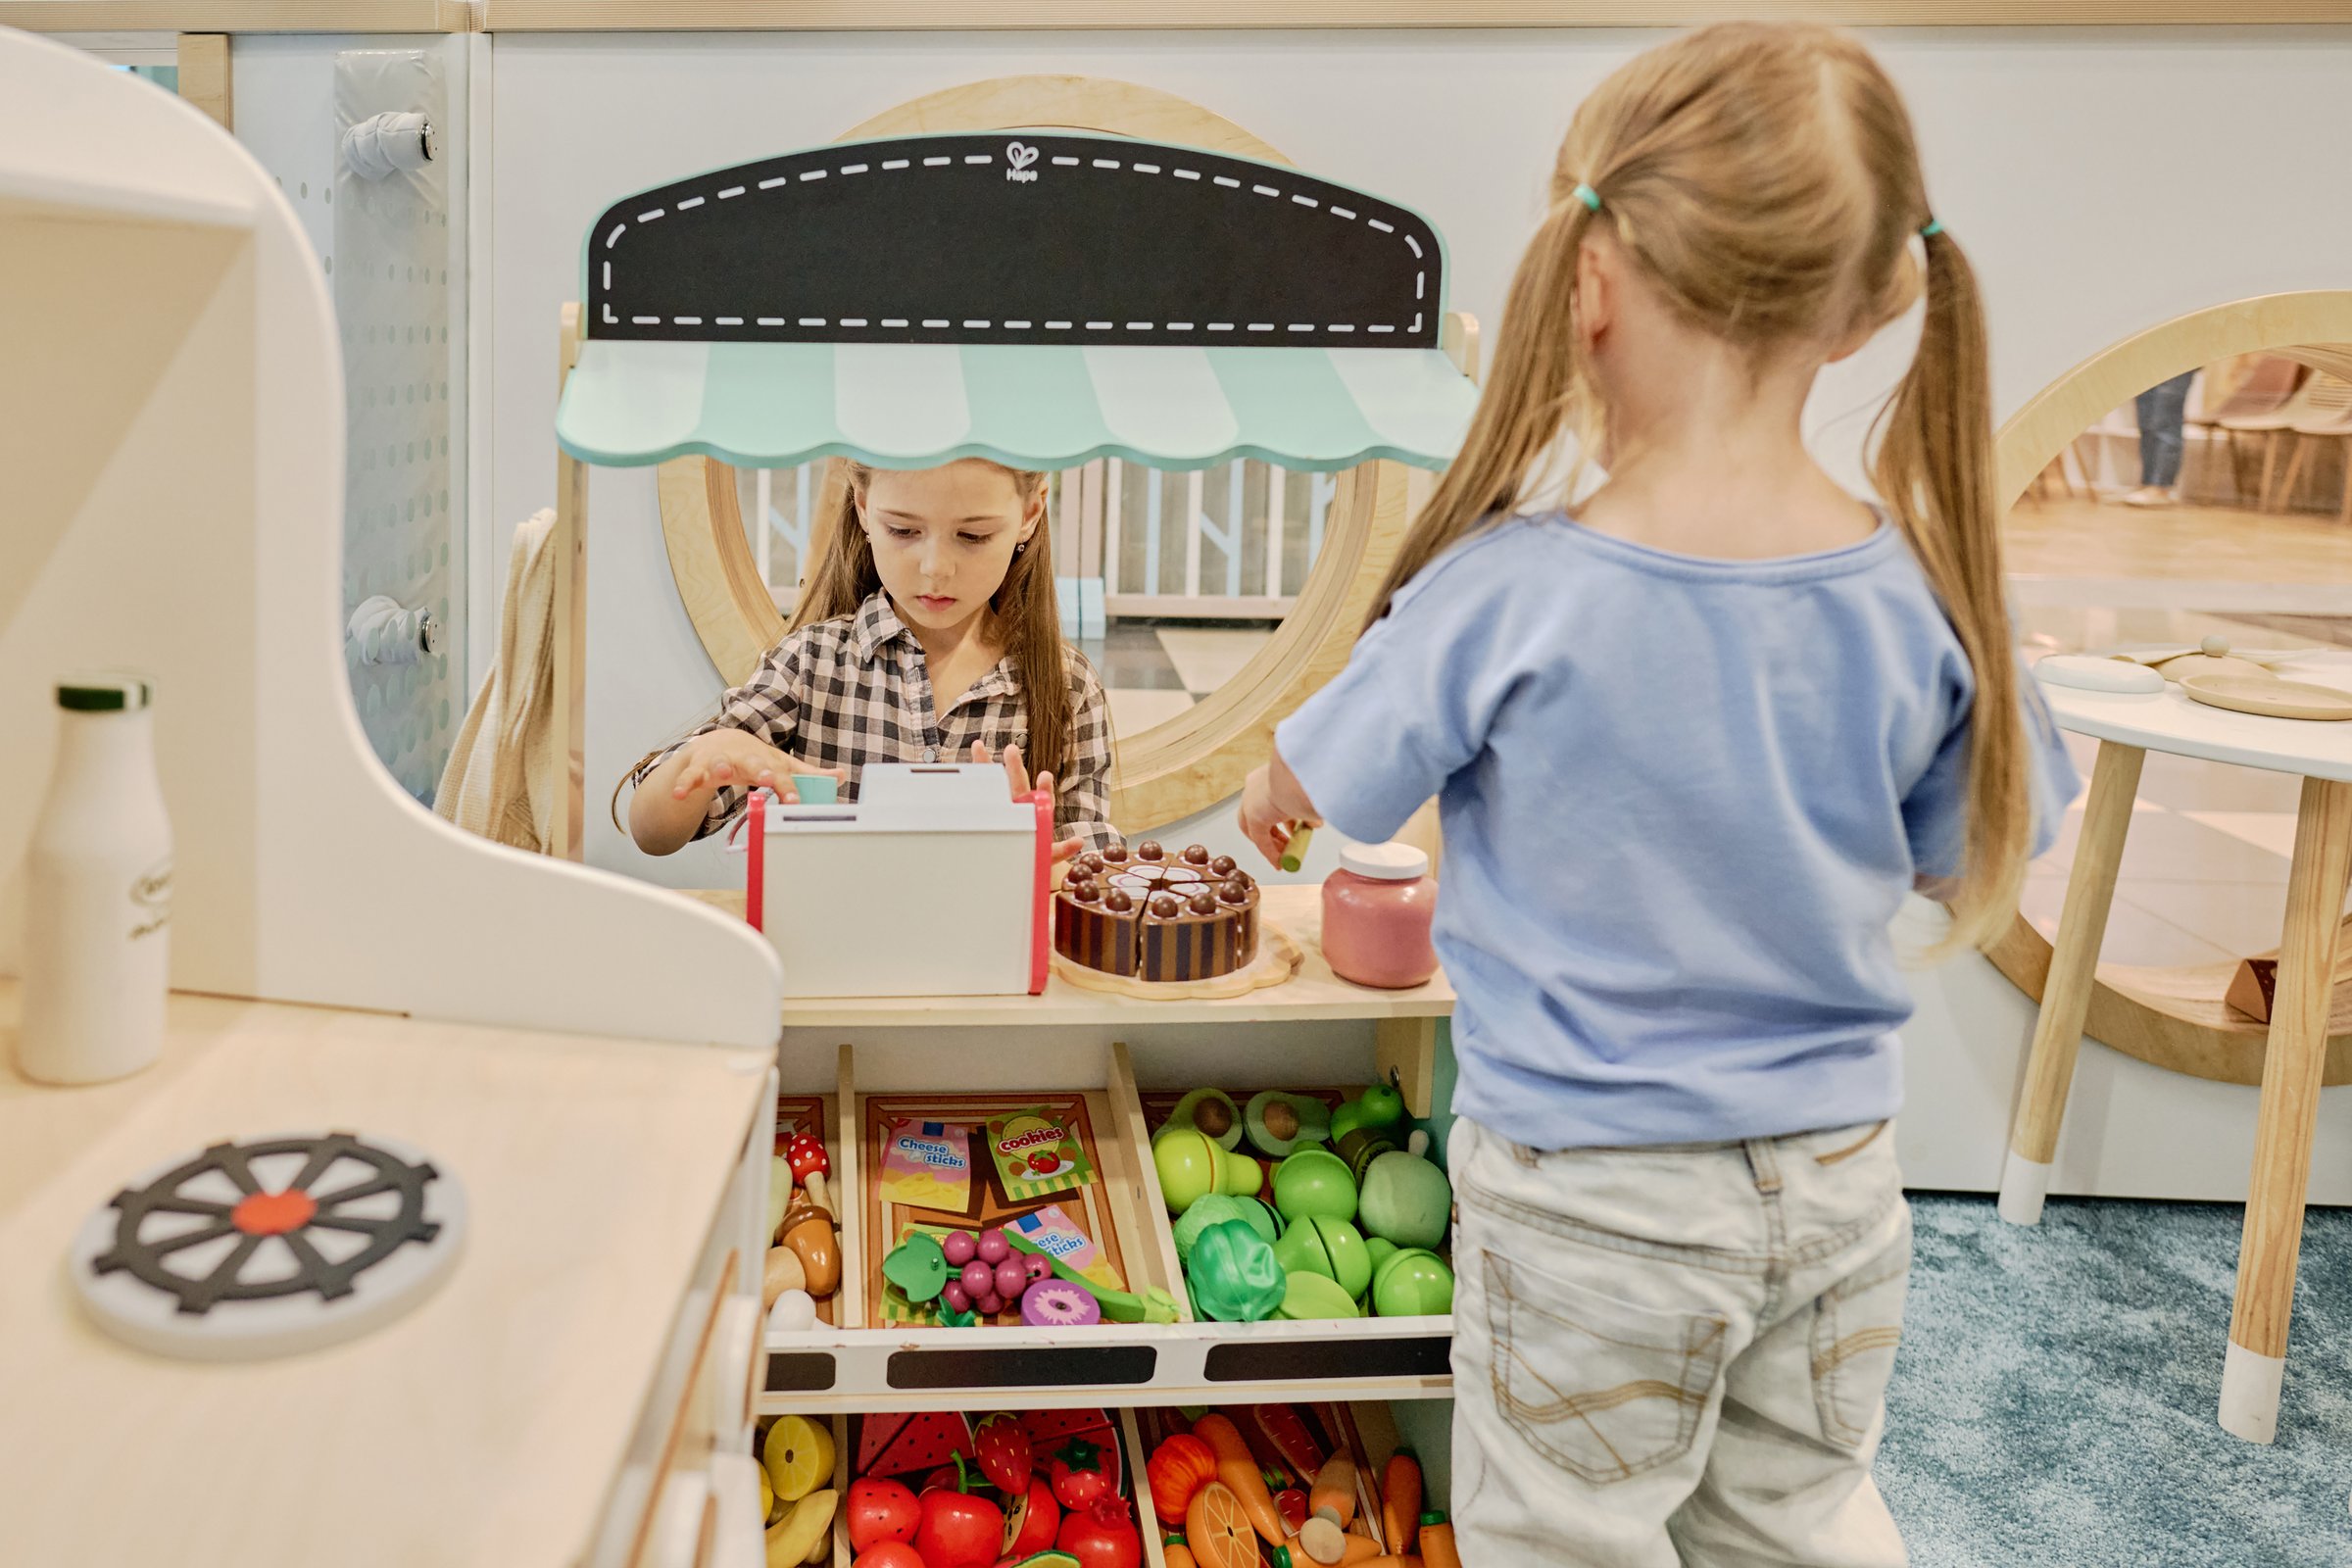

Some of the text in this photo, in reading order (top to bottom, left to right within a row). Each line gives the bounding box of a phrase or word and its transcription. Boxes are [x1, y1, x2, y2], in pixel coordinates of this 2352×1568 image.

[898, 1137, 949, 1154] Cheese
[1000, 1127, 1063, 1152] cookies
[925, 1152, 965, 1168] sticks
[1036, 1233, 1059, 1248] ese
